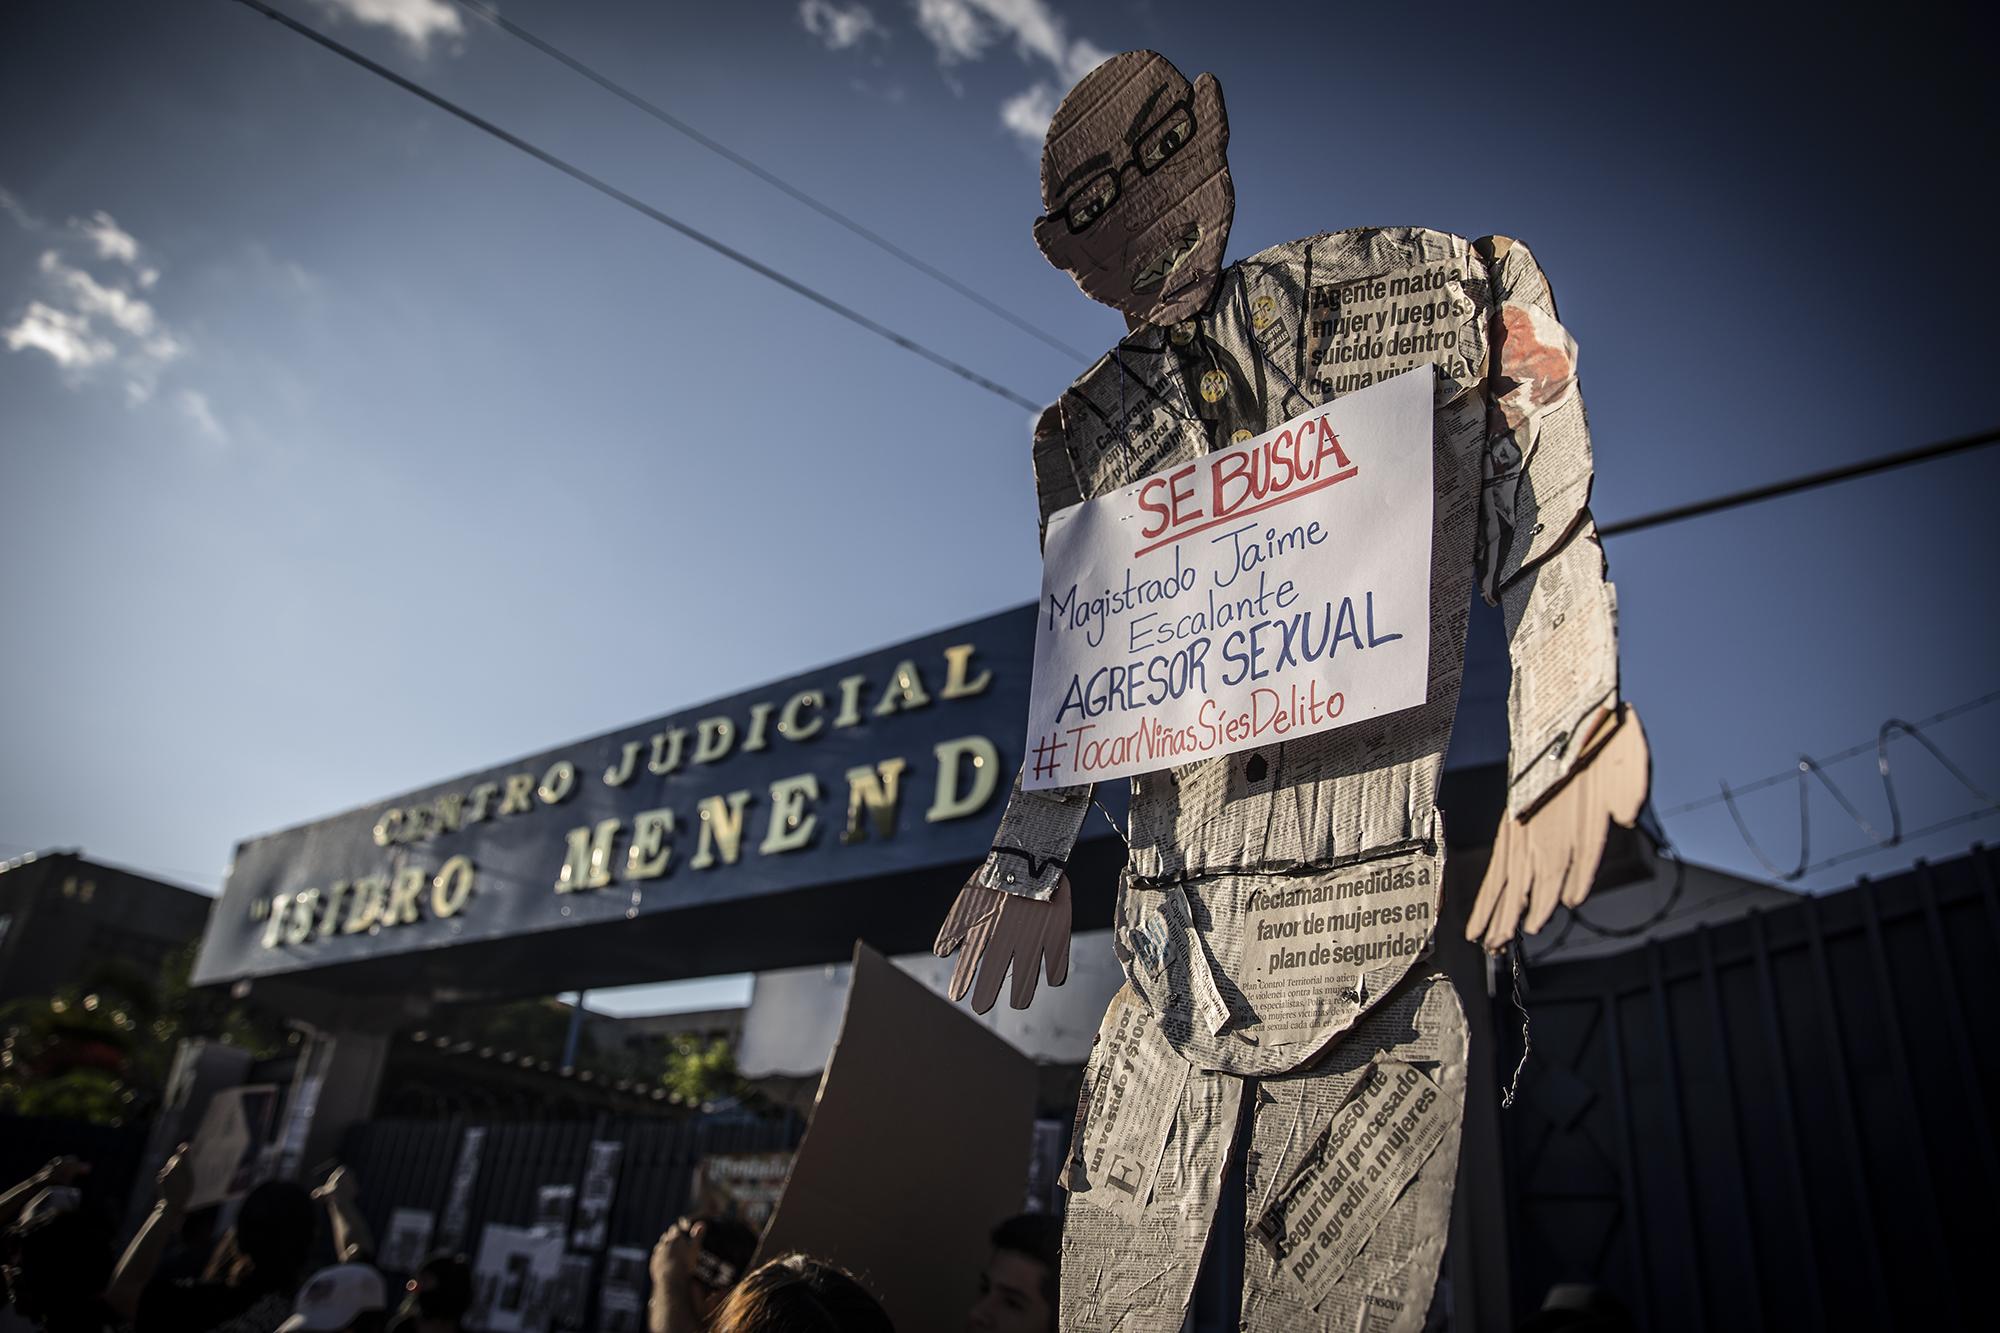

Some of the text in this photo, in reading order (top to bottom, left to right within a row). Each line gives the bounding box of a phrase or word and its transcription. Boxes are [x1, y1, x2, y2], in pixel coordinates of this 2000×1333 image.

[1312, 279, 1387, 312] Agente
[1389, 266, 1446, 298] mató
[1312, 296, 1474, 339] mujer y luego se
[1311, 329, 1457, 367] suicidó dentro
[1310, 371, 1333, 396] de
[1335, 372, 1374, 394] una
[1148, 420, 1170, 445] por
[1138, 464, 1204, 539] SE
[1211, 415, 1351, 518] BUSCA
[1049, 520, 1329, 648] Magistrado Jaime
[1129, 571, 1300, 654] Escalante
[1055, 591, 1403, 724] AGRESOR SEXUAL
[373, 643, 993, 848] CENTRO JUDICIAL
[1247, 867, 1431, 912] Reclaman medidas a
[1257, 901, 1430, 941] favor de mujeres en
[1268, 946, 1306, 974] plan
[1308, 942, 1330, 966] de
[1115, 1008, 1133, 1042] por
[1087, 1145, 1105, 1173] un
[1098, 1072, 1129, 1145] vestido
[1122, 1058, 1133, 1073] y
[1320, 1091, 1370, 1159] asesor
[1365, 1070, 1388, 1097] de
[1373, 1085, 1437, 1168] mujeres
[1275, 1158, 1352, 1256] Seguridad
[1346, 1067, 1420, 1170] procesado
[1366, 1164, 1383, 1183] a
[1318, 1180, 1370, 1249] agredir
[1290, 1239, 1323, 1282] por
